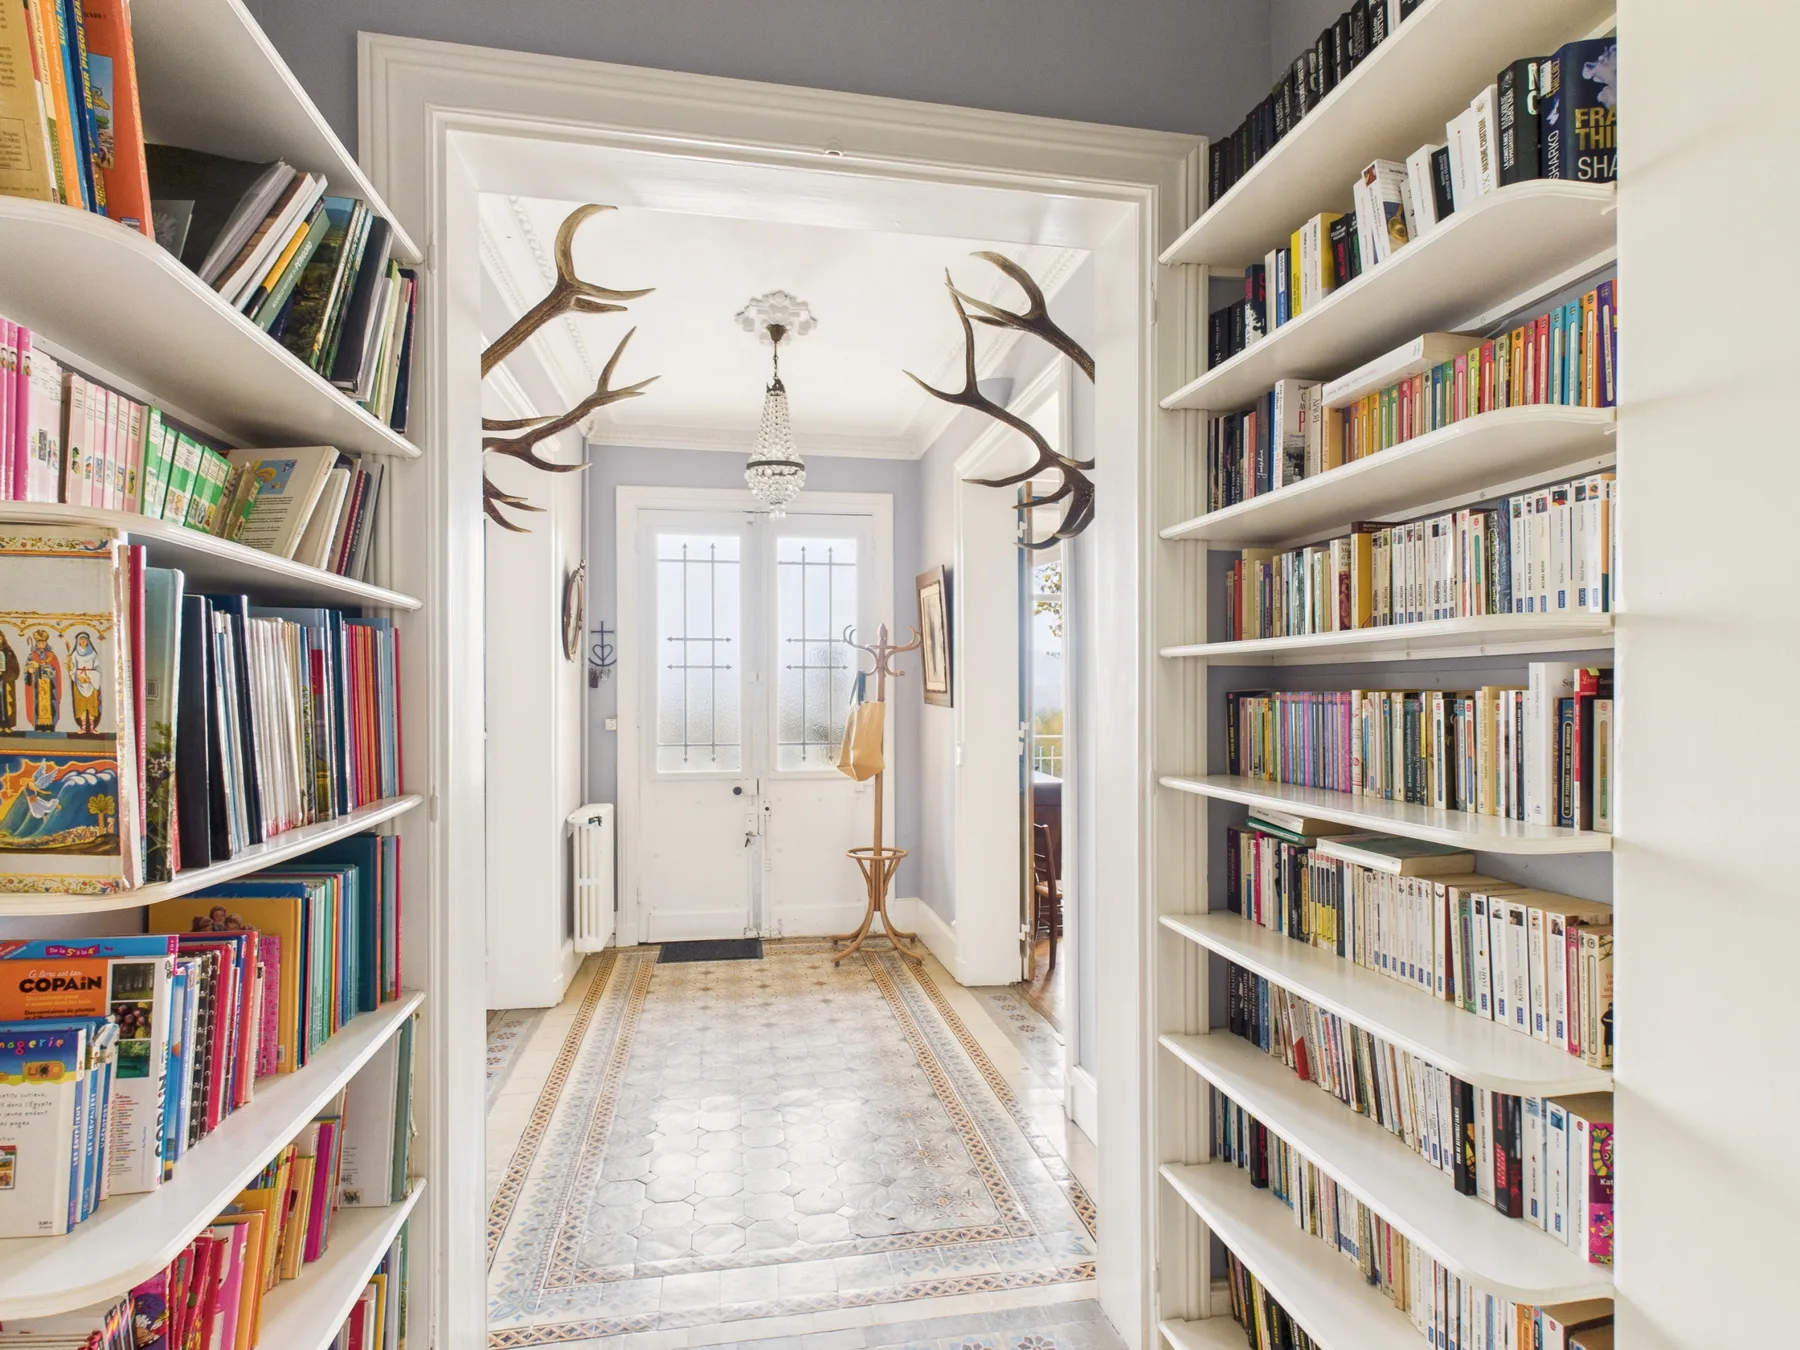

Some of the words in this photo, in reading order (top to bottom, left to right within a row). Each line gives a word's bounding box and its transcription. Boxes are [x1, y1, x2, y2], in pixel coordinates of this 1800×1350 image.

[57, 17, 66, 46] SUPER
[78, 26, 89, 69] PICSOU
[84, 72, 94, 110] SUPER
[1548, 130, 1560, 179] SHARKO
